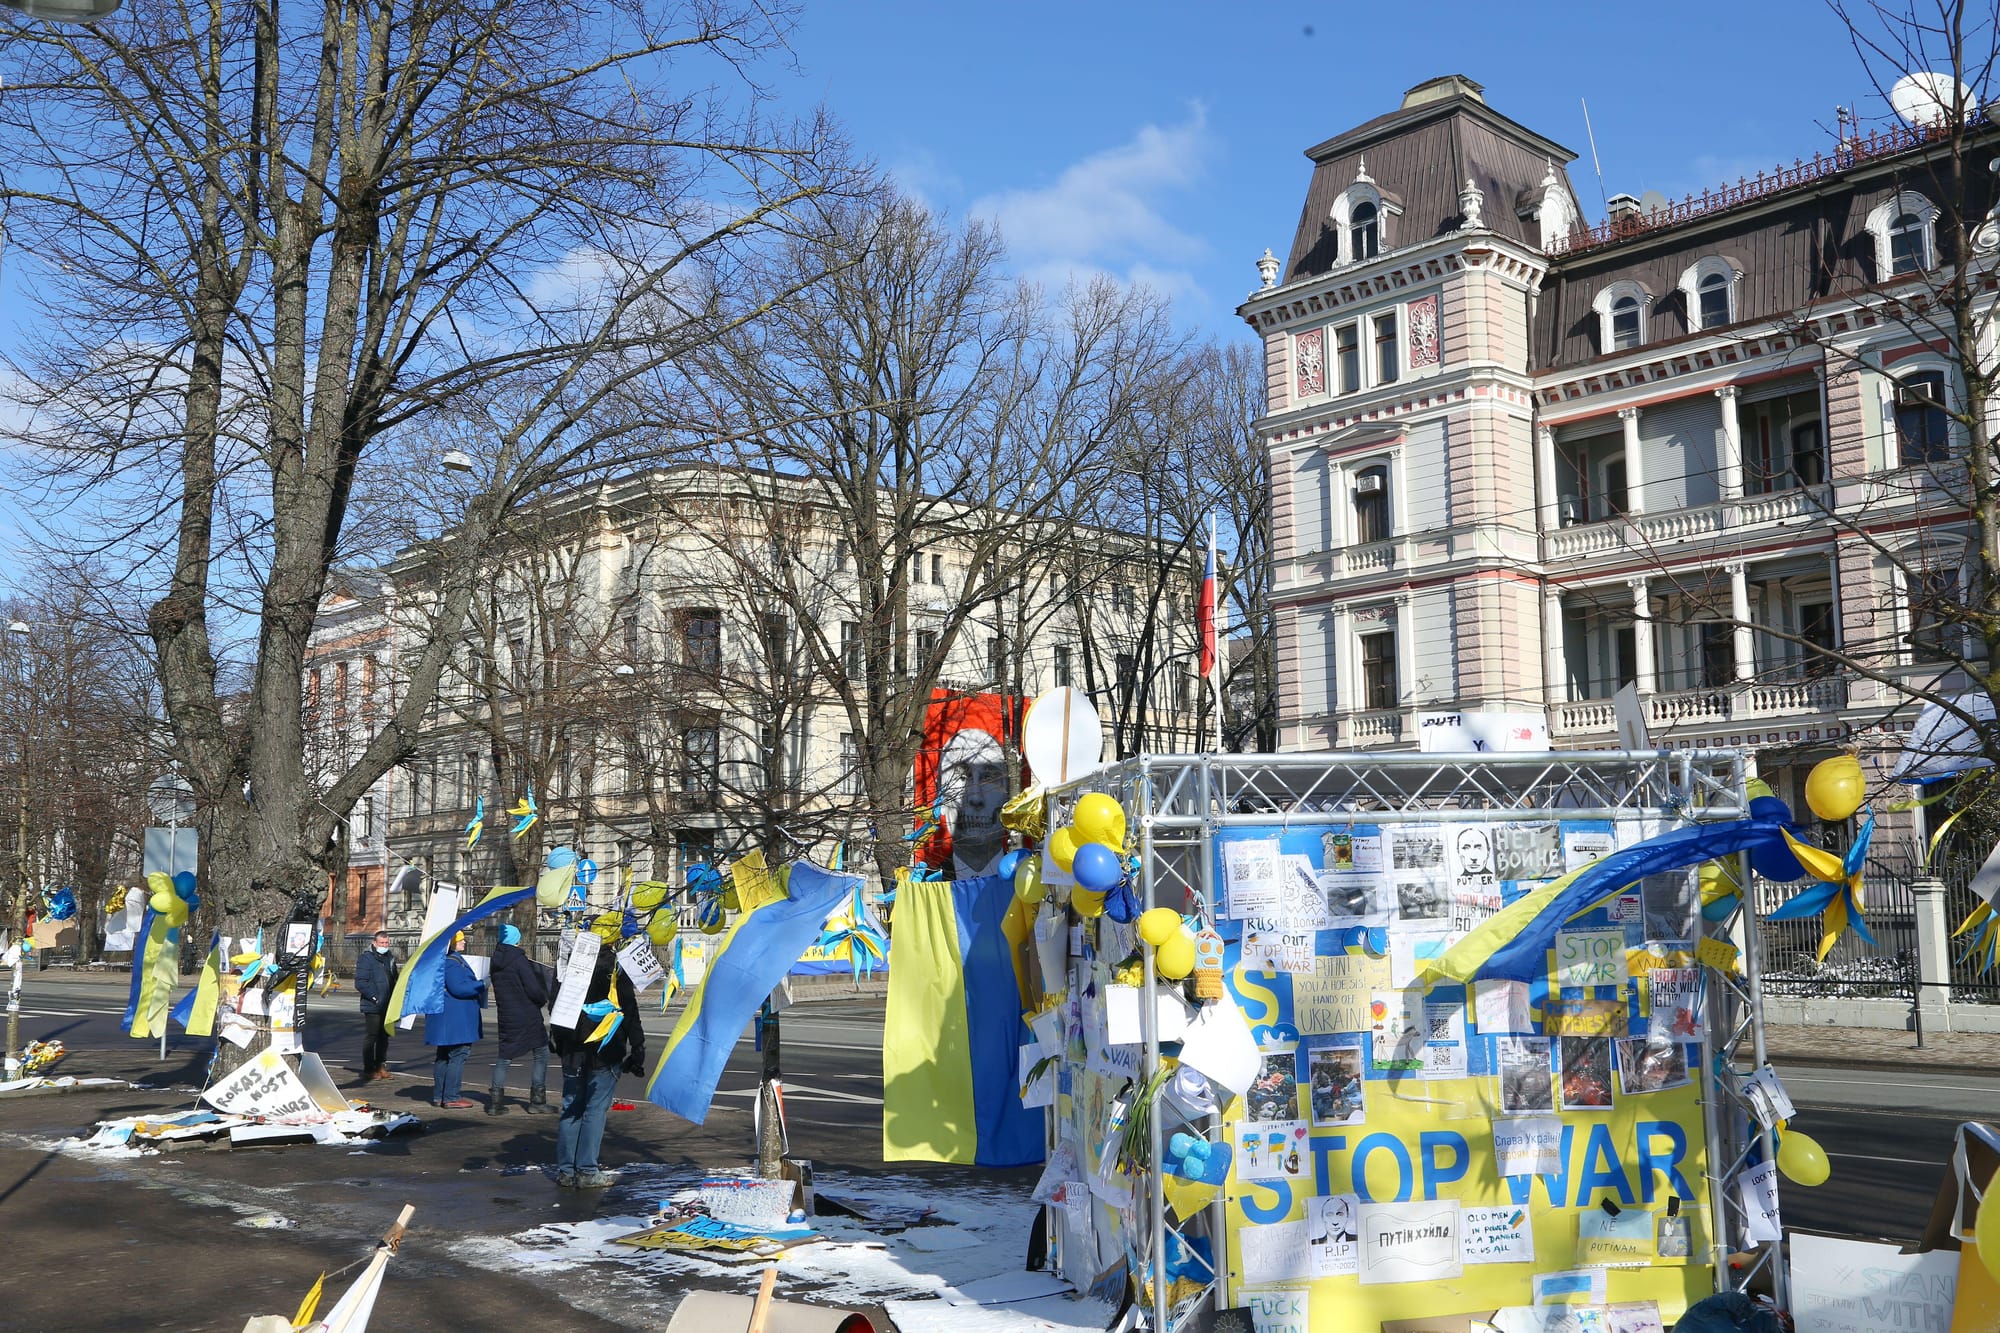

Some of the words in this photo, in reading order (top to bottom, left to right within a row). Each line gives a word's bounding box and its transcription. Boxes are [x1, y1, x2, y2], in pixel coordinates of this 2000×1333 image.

[1496, 829, 1537, 850] НЕТ
[1457, 876, 1493, 886] PUTER
[1456, 894, 1478, 907] HOW
[1482, 895, 1501, 908] FAR
[1456, 906, 1476, 917] THIS
[1243, 944, 1282, 957] STOP
[1284, 946, 1311, 960] THE
[1562, 936, 1622, 960] STOP
[1281, 959, 1311, 971] WAR
[1568, 961, 1617, 983] WAR
[1655, 969, 1678, 982] HOW
[1681, 969, 1699, 982] FAR
[1299, 981, 1319, 993] YOU
[1321, 981, 1328, 991] A
[1655, 982, 1676, 993] THIS
[1680, 982, 1700, 993] WILL
[1312, 994, 1338, 1005] HANDS
[1341, 994, 1355, 1004] OFF
[1111, 1048, 1138, 1072] WAR
[216, 1068, 263, 1108] ROKAS
[250, 1070, 287, 1101] NOST
[1494, 1135, 1523, 1147] Слава
[1239, 1130, 1470, 1225] STOP
[1503, 1120, 1695, 1209] WAR
[1751, 1172, 1768, 1186] LOCK
[1467, 1213, 1488, 1222] OLD
[1491, 1211, 1509, 1220] MEN
[1472, 1227, 1480, 1235] IN
[1484, 1224, 1509, 1234] POWER
[1379, 1228, 1413, 1248] ПУТІН
[1489, 1232, 1522, 1244] DANGER
[1480, 1246, 1491, 1254] US
[1493, 1244, 1511, 1254] ALL
[1320, 1261, 1357, 1272] 19-2022
[1250, 1298, 1302, 1316] FUCK
[1862, 1296, 1945, 1331] WITH
